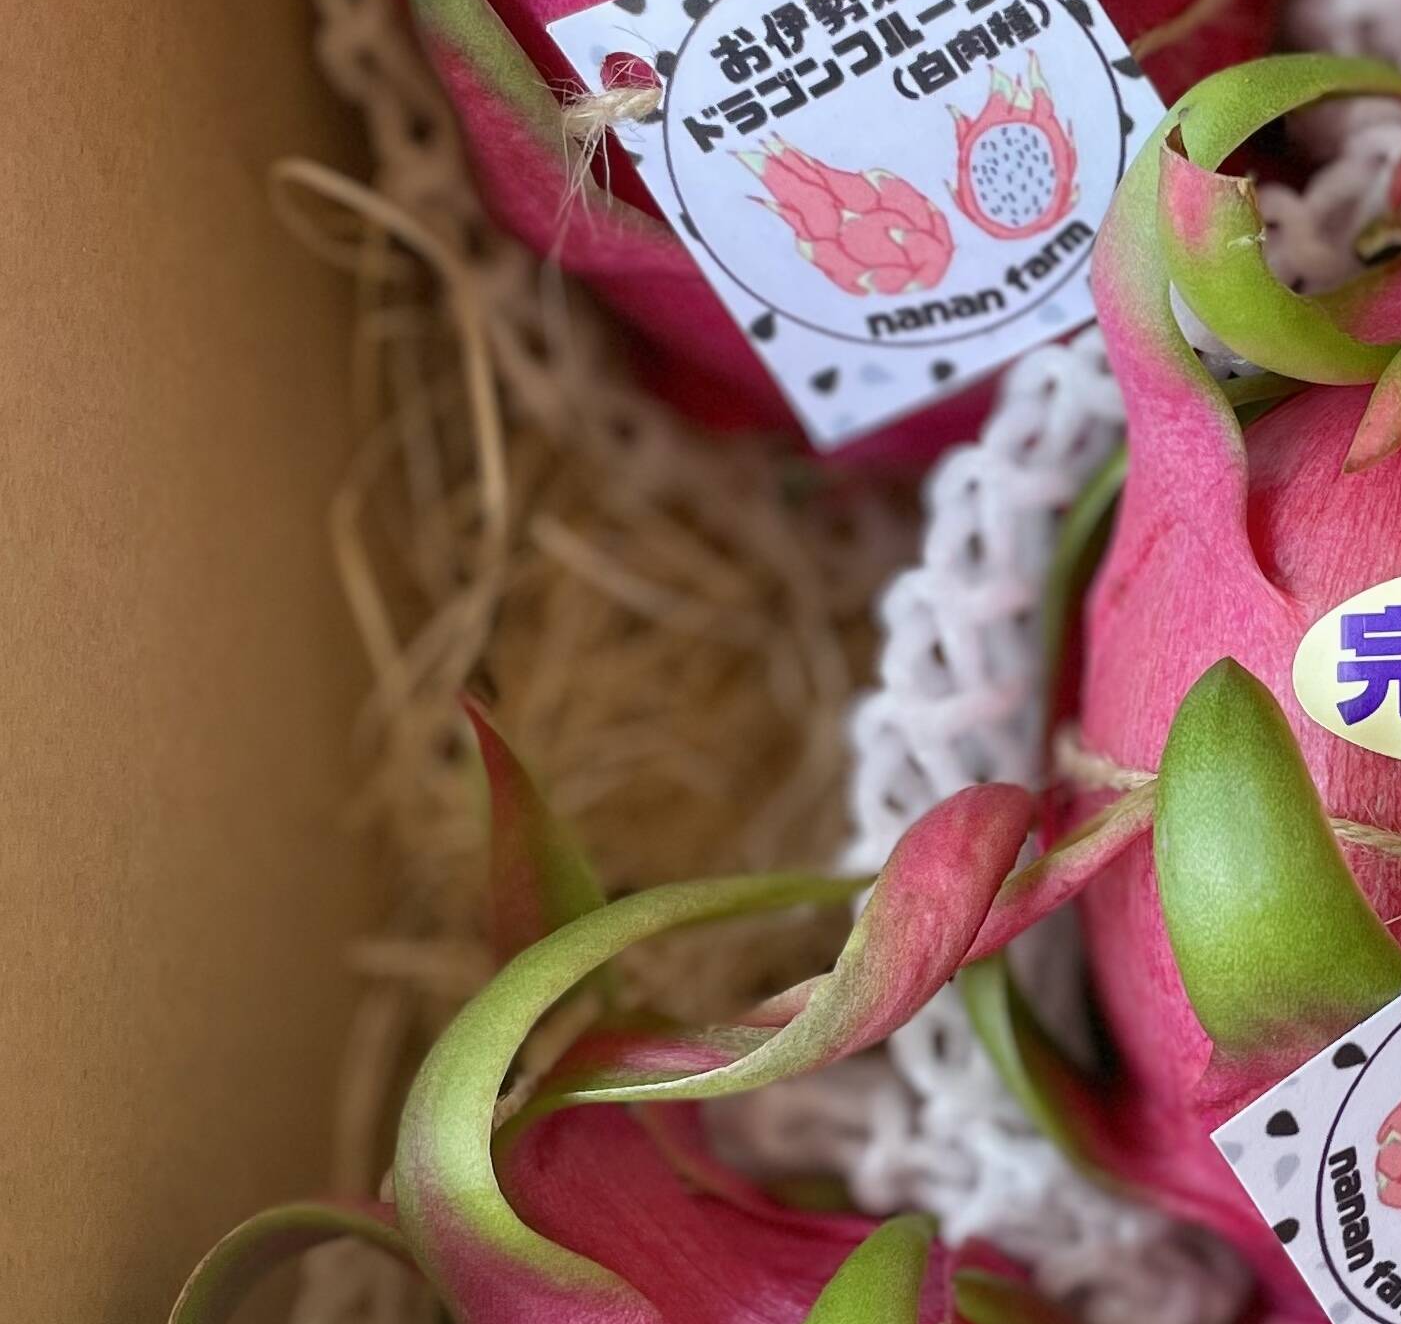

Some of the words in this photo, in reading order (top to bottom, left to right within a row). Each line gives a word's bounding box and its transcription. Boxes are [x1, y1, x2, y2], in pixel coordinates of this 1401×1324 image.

[867, 285, 1006, 338] nanan
[1004, 219, 1094, 294] farm
[1328, 1146, 1375, 1272] nanan
